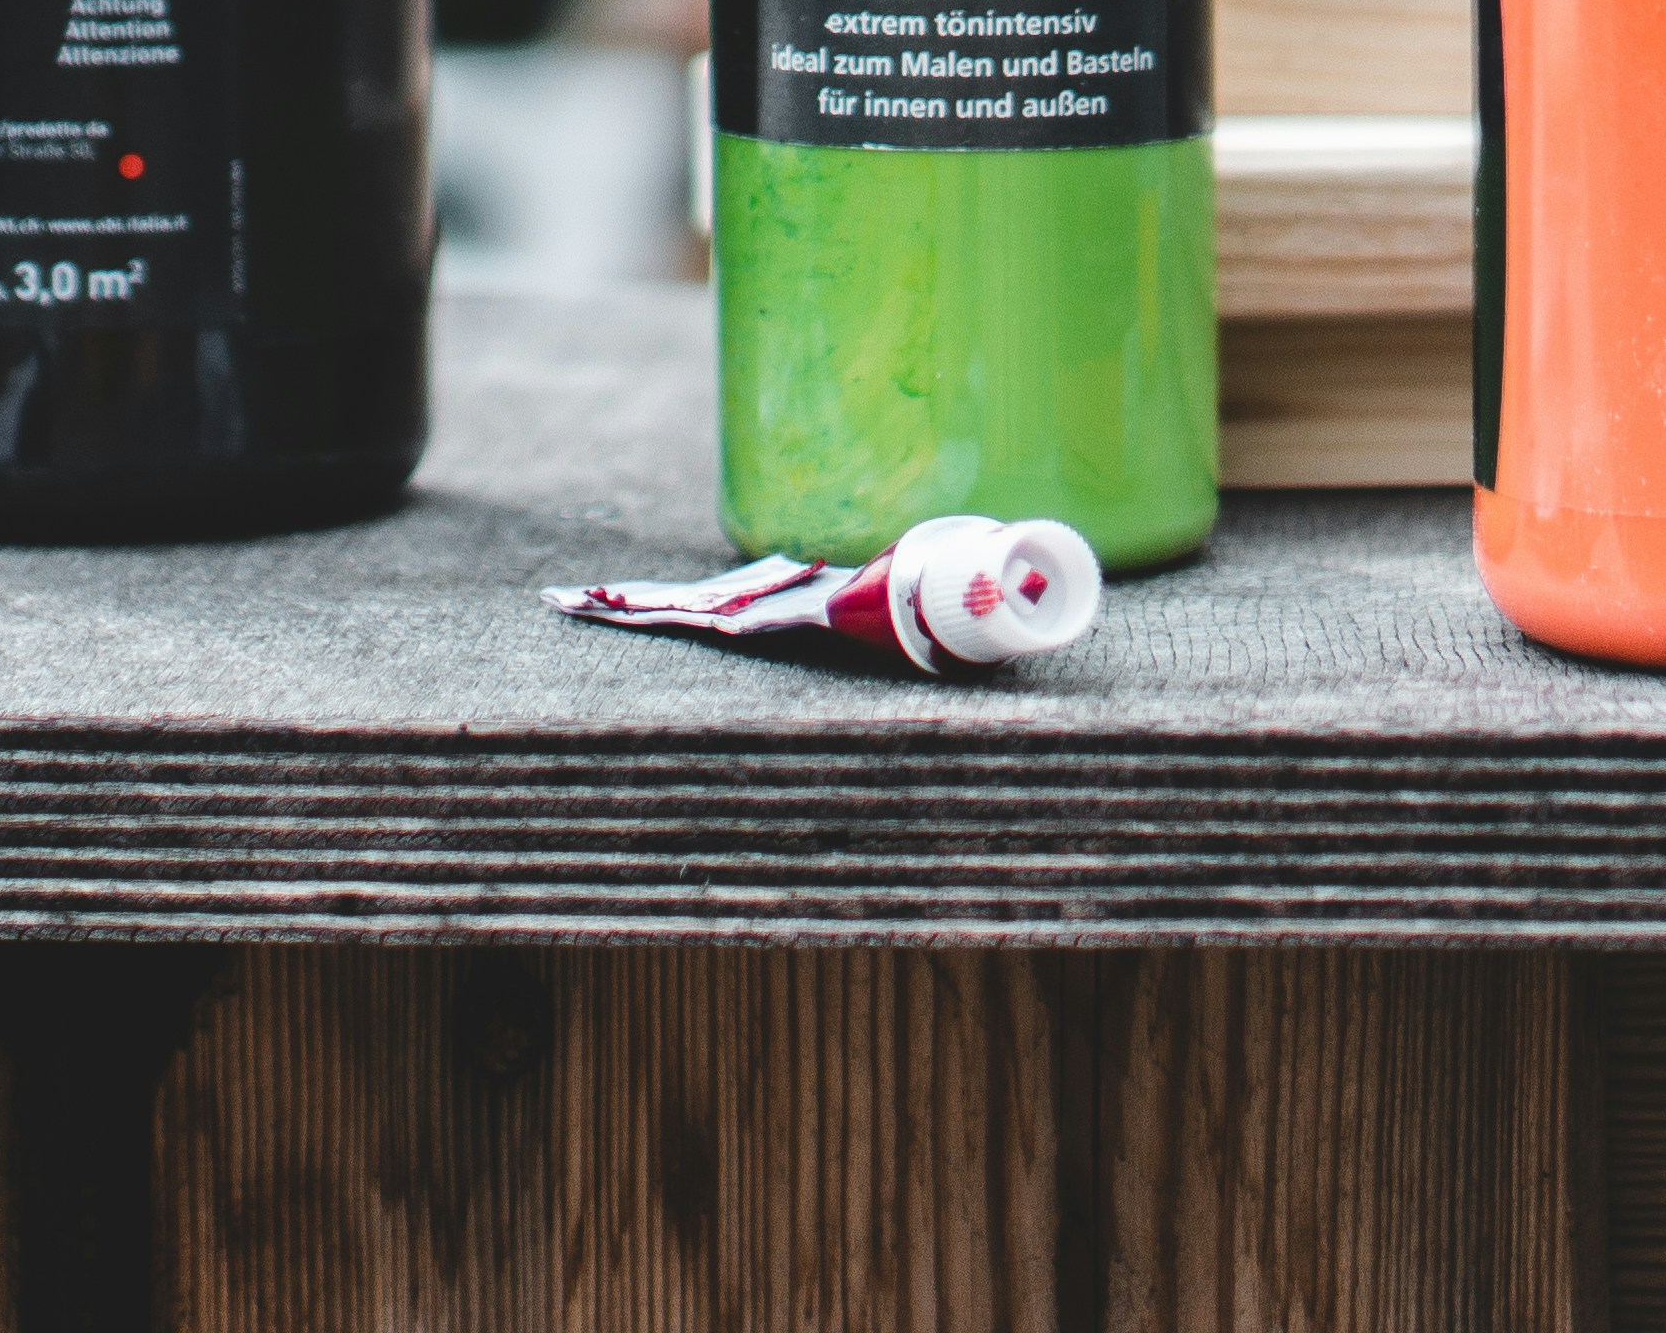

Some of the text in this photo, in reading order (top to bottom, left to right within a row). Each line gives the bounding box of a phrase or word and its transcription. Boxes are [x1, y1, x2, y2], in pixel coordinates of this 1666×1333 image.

[65, 18, 171, 41] Attention
[830, 8, 1096, 37] extrem tönintensiv
[57, 43, 181, 67] Attenzione
[771, 44, 1154, 77] ideal zum Malen und Basteln
[817, 90, 1107, 119] für innen und außen
[15, 261, 77, 305] 3,0
[88, 258, 146, 301] m²
